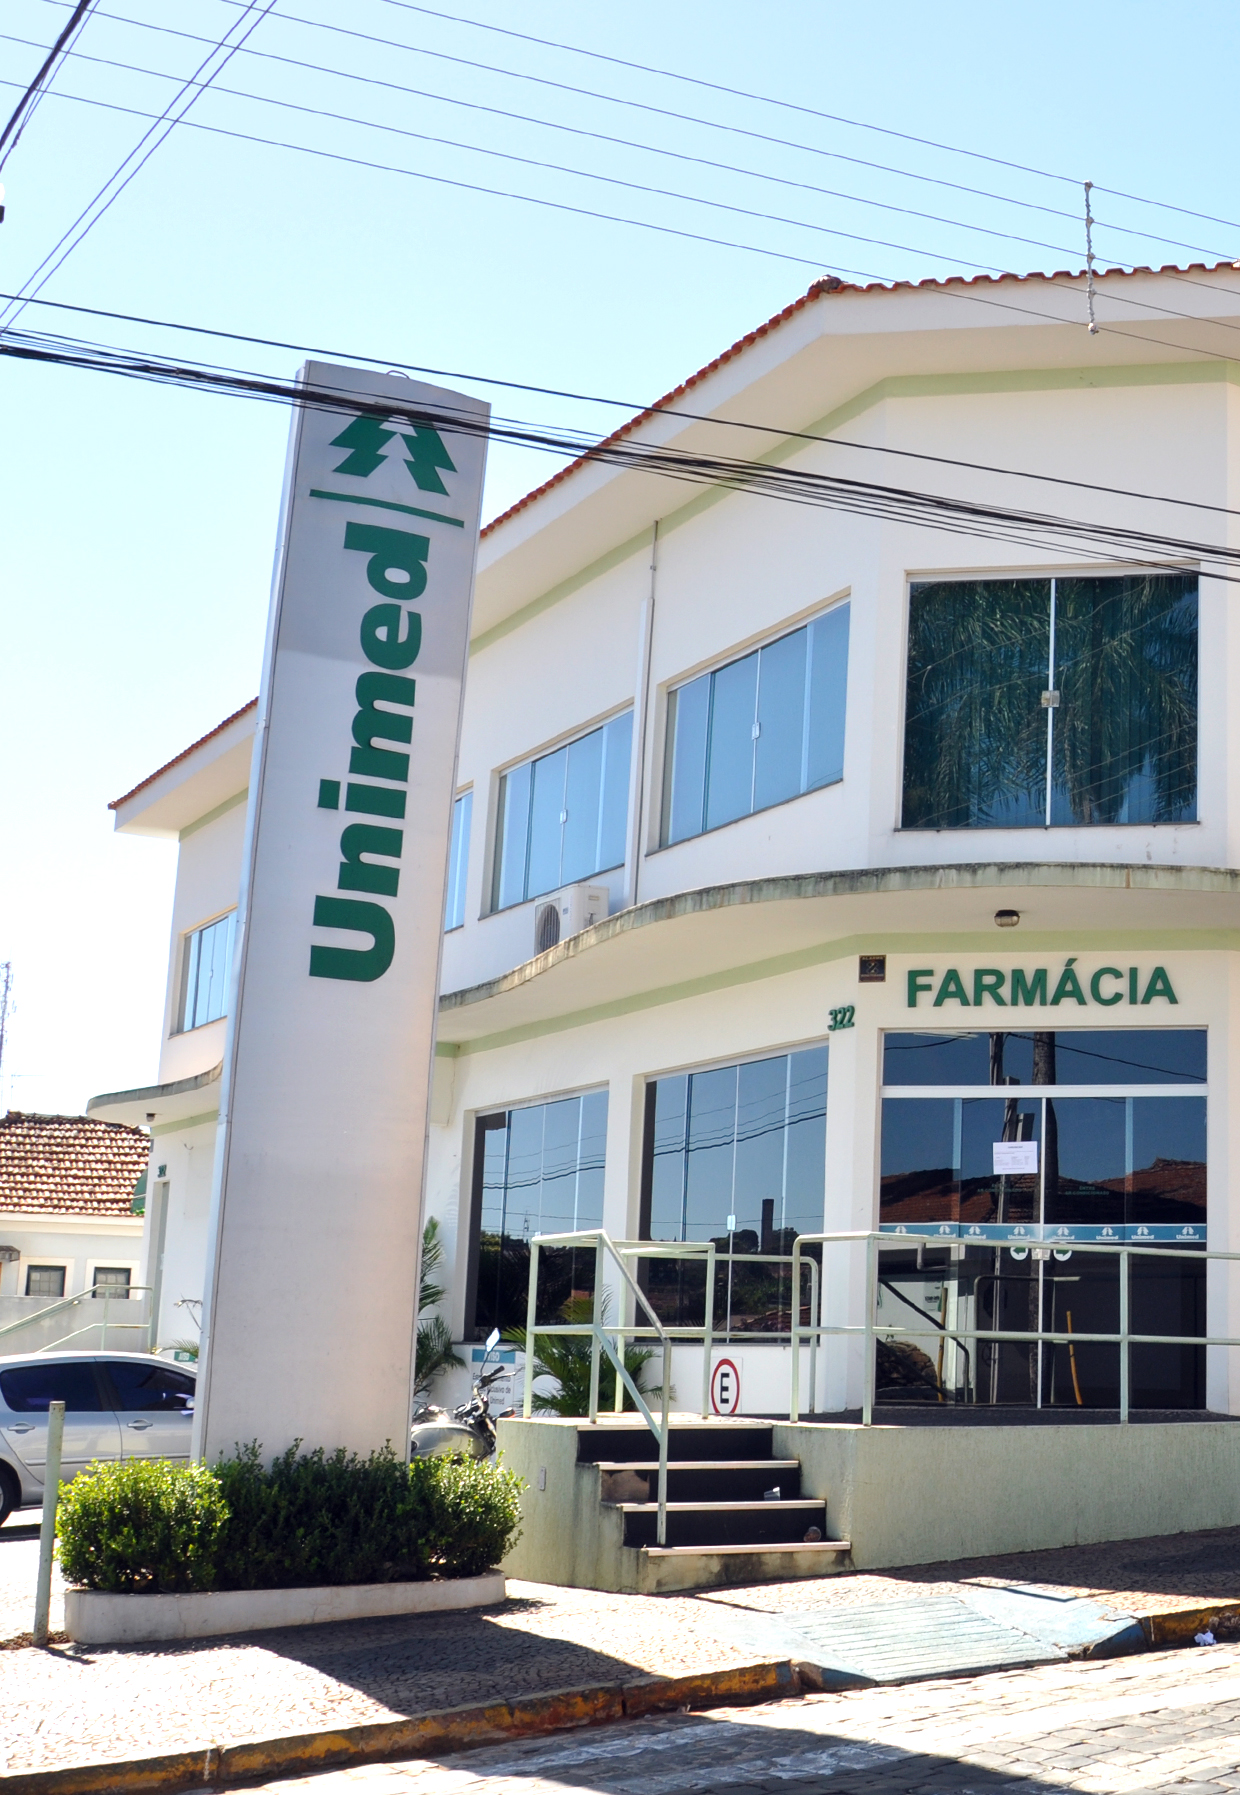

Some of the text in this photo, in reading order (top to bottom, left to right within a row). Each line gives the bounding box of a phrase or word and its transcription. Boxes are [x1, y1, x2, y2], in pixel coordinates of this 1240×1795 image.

[309, 521, 430, 983] Unimed
[907, 957, 1179, 1008] FARMÁCIA
[827, 1005, 856, 1031] 322
[720, 1372, 730, 1404] E
